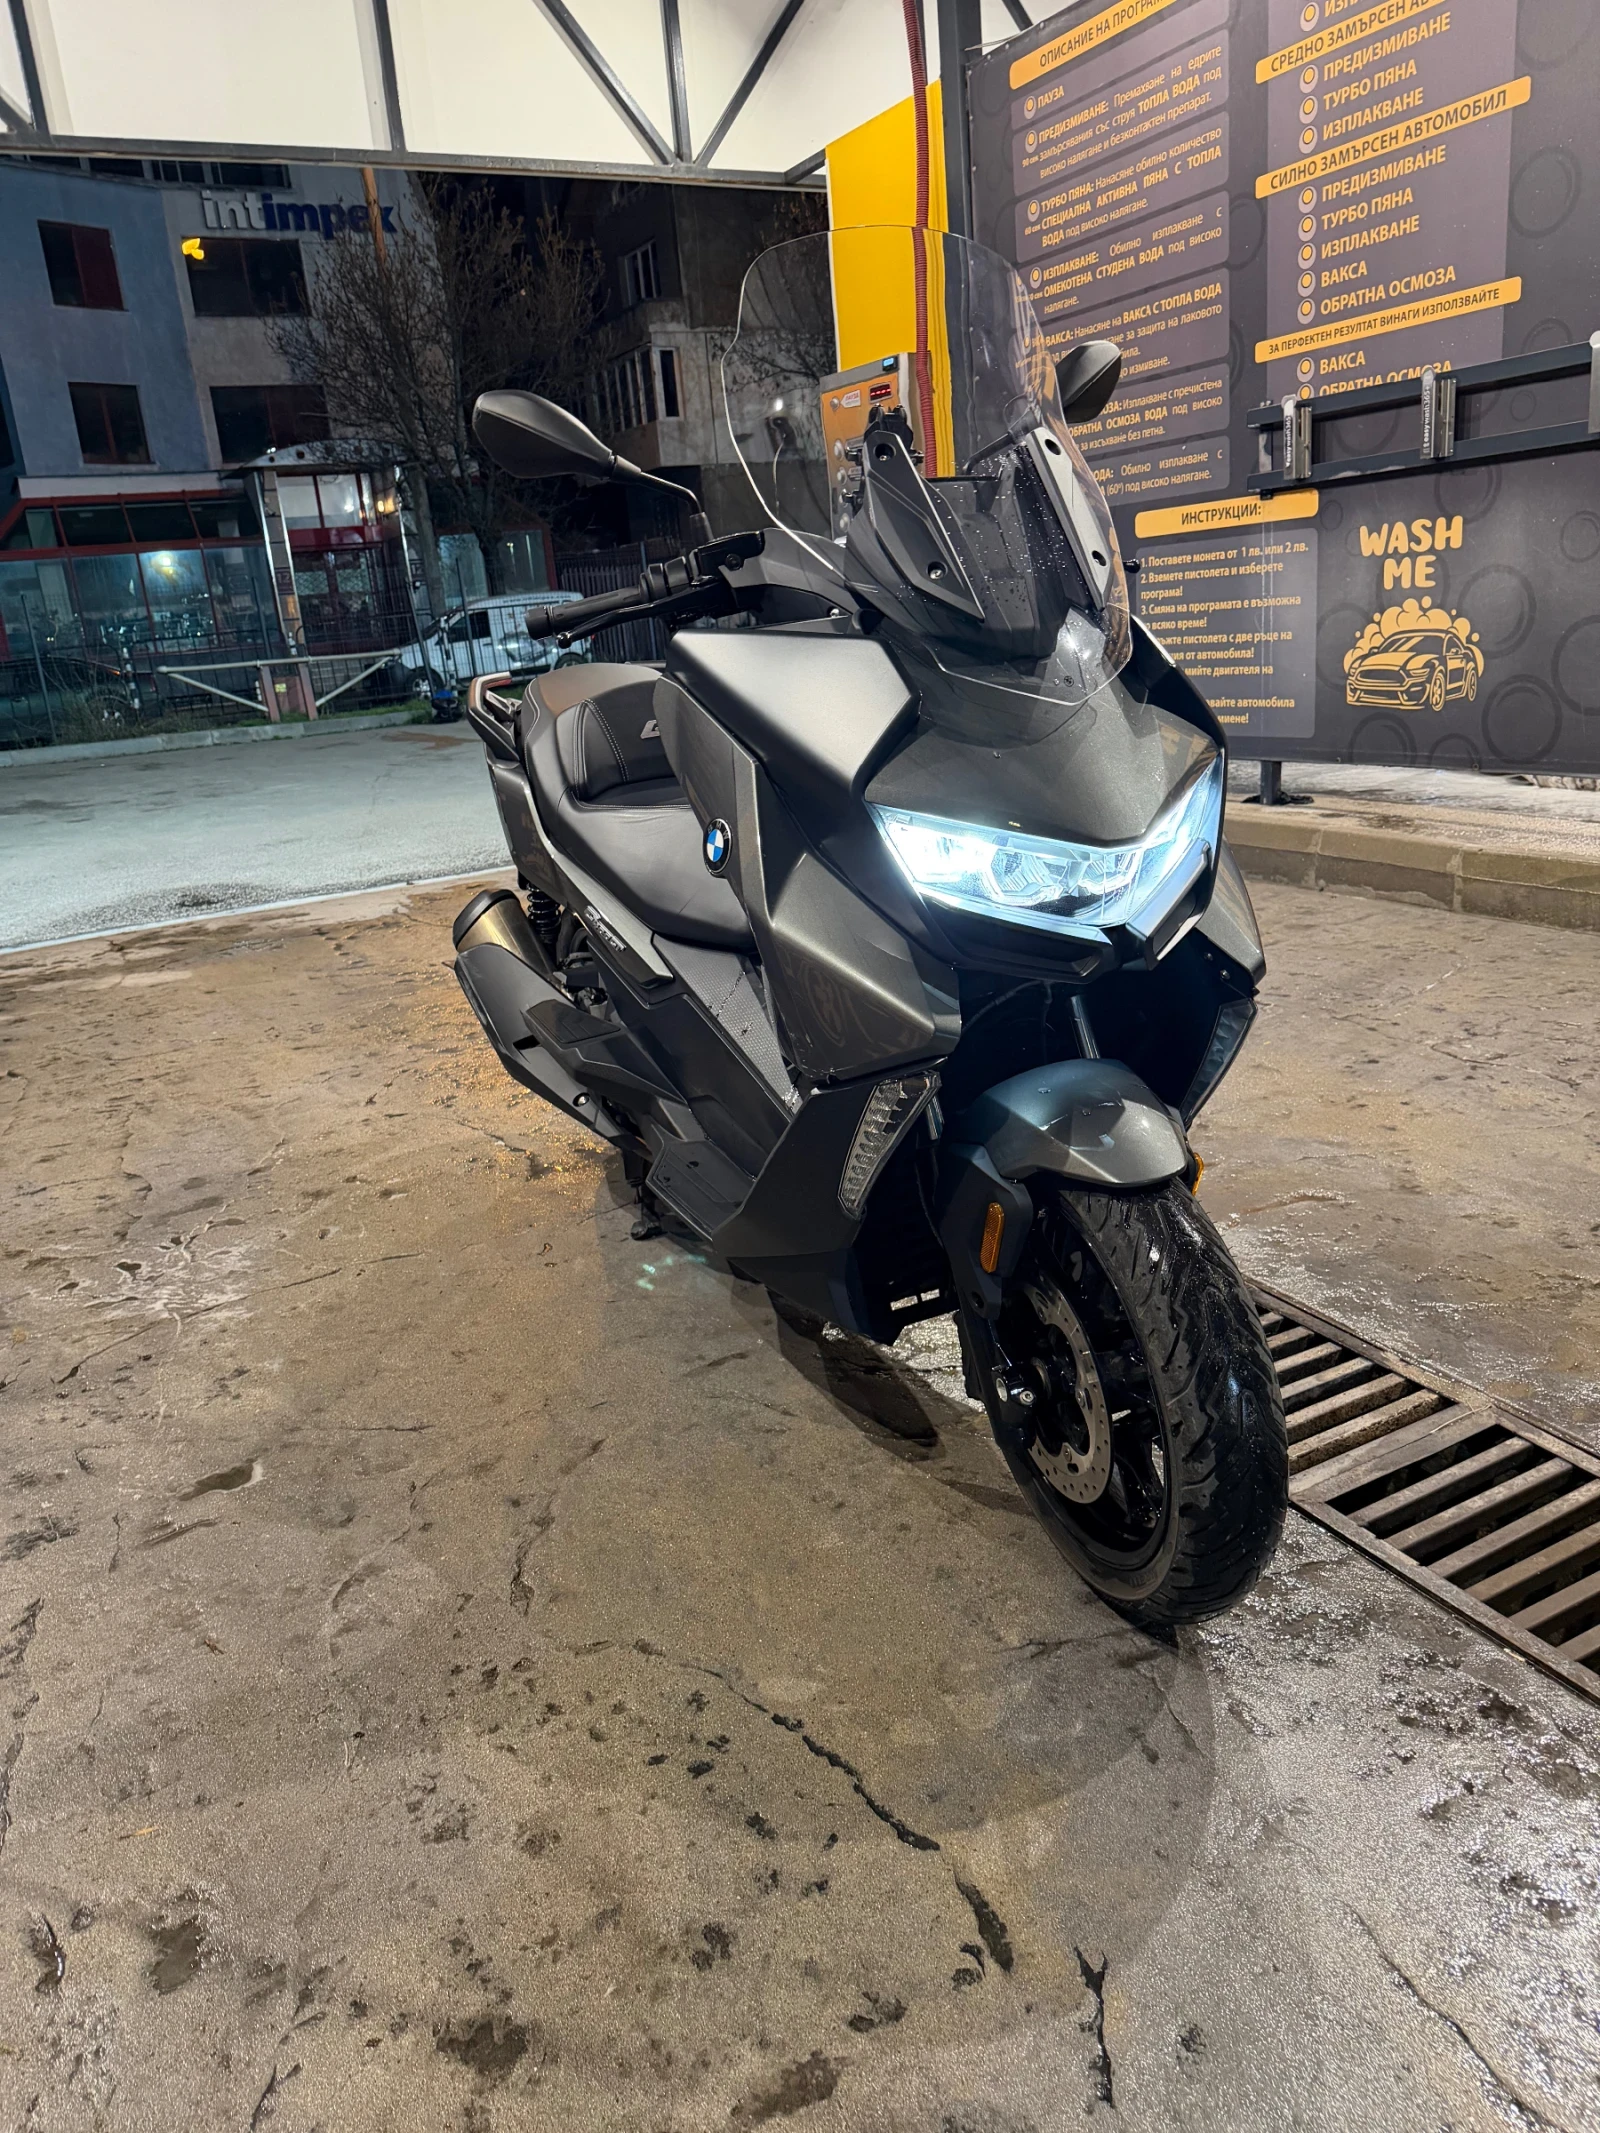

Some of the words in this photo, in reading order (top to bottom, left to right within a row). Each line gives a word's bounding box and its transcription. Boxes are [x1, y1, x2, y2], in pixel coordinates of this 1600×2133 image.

[1040, 28, 1094, 67] ОПИСАНИЕ
[1096, 18, 1110, 38] НА
[1270, 37, 1324, 74] СРЕДНО
[1327, 1, 1406, 48] ЗАМЪРСЕН
[1323, 11, 1451, 82] ПРЕДИЗМИВАНЕ
[1037, 85, 1064, 109] ПАУЗА
[1039, 100, 1109, 143] ПРЕДИЗМИВАНЕ:
[1114, 75, 1166, 107] Премахване
[1171, 64, 1182, 79] на
[1112, 110, 1135, 131] струя
[1138, 88, 1169, 113] ТОПЛА
[1172, 75, 1200, 98] ВОДА
[1203, 66, 1222, 86] под
[1323, 77, 1371, 112] ТУРБО
[1373, 59, 1418, 91] ПЯНА
[1322, 87, 1424, 141] ИЗПЛАКВАНЕ
[1040, 160, 1067, 179] високо
[1069, 139, 1103, 171] налягане
[1167, 91, 1212, 121] препарат.
[1270, 161, 1317, 191] СИЛНО
[1320, 125, 1399, 172] ЗАМЪРСЕН
[1403, 89, 1507, 143] АВТОМОБИЛ
[1040, 192, 1067, 213] ТУРБО
[1068, 180, 1094, 202] ПЯНА:
[1095, 166, 1134, 190] Нанасяне
[1135, 148, 1167, 172] обилно
[1169, 127, 1222, 157] количество
[1041, 200, 1091, 230] СПЕЦИАЛНА
[1096, 182, 1137, 209] АКТИВНА
[1143, 167, 1168, 189] ПЯНА
[1187, 145, 1222, 170] ТОПЛА
[1322, 144, 1447, 203] ПРЕДИЗМИВАНЕ
[1042, 230, 1065, 247] ВОДА
[1065, 225, 1080, 239] под
[1080, 211, 1109, 232] високо
[1110, 198, 1149, 222] налягане.
[1322, 200, 1369, 231] ТУРБО
[1370, 187, 1414, 214] ПЯНА
[1043, 252, 1099, 282] ИЗПЛАКВАНЕ:
[1110, 238, 1142, 257] Обилно
[1152, 214, 1204, 241] изплакване
[1321, 214, 1420, 260] ИЗПЛАКВАНЕ
[1044, 271, 1093, 298] ОМЕКОТЕНА
[1096, 256, 1135, 279] СТУДЕНА
[1138, 244, 1164, 265] ВОДА
[1168, 242, 1185, 254] под
[1189, 225, 1222, 246] високо
[1320, 260, 1368, 288] ВАКСА
[1044, 295, 1080, 314] налягане.
[1320, 282, 1385, 316] ОБРАТНА
[1388, 265, 1457, 298] ОСМОЗА
[1046, 328, 1073, 346] ВАКСА:
[1074, 315, 1111, 339] Нанасяне
[1112, 316, 1122, 329] на
[1122, 304, 1151, 324] ВАКСА
[1159, 290, 1192, 312] ТОПЛА
[1194, 283, 1222, 303] ВОДА
[1125, 329, 1135, 340] за
[1137, 318, 1165, 337] защита
[1168, 315, 1179, 327] на
[1180, 304, 1222, 325] лаковото
[1269, 343, 1279, 354] ЗА
[1281, 329, 1332, 351] ПЕРФЕКТЕН
[1333, 318, 1378, 339] РЕЗУЛТАТ
[1380, 307, 1421, 327] ВИНАГИ
[1422, 288, 1500, 318] ИЗПОЛЗВАЙТЕ
[1129, 355, 1171, 376] измиване.
[1319, 350, 1365, 376] ВАКСА
[1123, 391, 1167, 409] Изплакване
[1174, 379, 1222, 399] пречистена
[1106, 413, 1140, 430] ОСМОЗА
[1145, 407, 1168, 422] ВОДА
[1172, 403, 1188, 415] под
[1192, 396, 1223, 410] високо
[1089, 432, 1126, 448] изсъхване
[1128, 429, 1140, 441] без
[1142, 425, 1165, 438] петна.
[1121, 462, 1151, 476] Обилно
[1159, 451, 1209, 469] изплакване
[1125, 479, 1140, 492] под
[1142, 476, 1169, 489] високо
[1171, 469, 1212, 485] налягане.
[1181, 503, 1262, 525] ИНСТРУКЦИИ:
[1148, 552, 1191, 567] Поставете
[1193, 550, 1226, 562] монета
[1227, 550, 1238, 559] от
[1241, 547, 1246, 557] 1
[1248, 547, 1263, 557] лв.
[1265, 544, 1283, 554] или
[1285, 543, 1292, 553] 2
[1293, 542, 1308, 552] лв.
[1359, 515, 1464, 557] WASH
[1149, 569, 1183, 582] Вземете
[1184, 565, 1230, 579] пистолета
[1231, 566, 1238, 574] и
[1239, 562, 1283, 574] изберете
[1383, 554, 1437, 591] ME
[1141, 586, 1183, 601] програма!
[1148, 602, 1175, 614] Смяна
[1177, 602, 1187, 612] на
[1189, 598, 1242, 613] програмата
[1243, 599, 1249, 608] е
[1251, 595, 1301, 607] възможна
[1152, 622, 1176, 633] всяко
[1177, 617, 1207, 630] време!
[1183, 631, 1228, 644] пистолета
[1229, 633, 1234, 641] с
[1235, 632, 1252, 644] две
[1254, 630, 1277, 642] ръце
[1280, 630, 1292, 640] на
[1186, 650, 1195, 661] от
[1196, 647, 1254, 659] автомобила!
[1213, 663, 1260, 677] двигателя
[1262, 664, 1273, 674] на
[1237, 696, 1295, 708] автомобила
